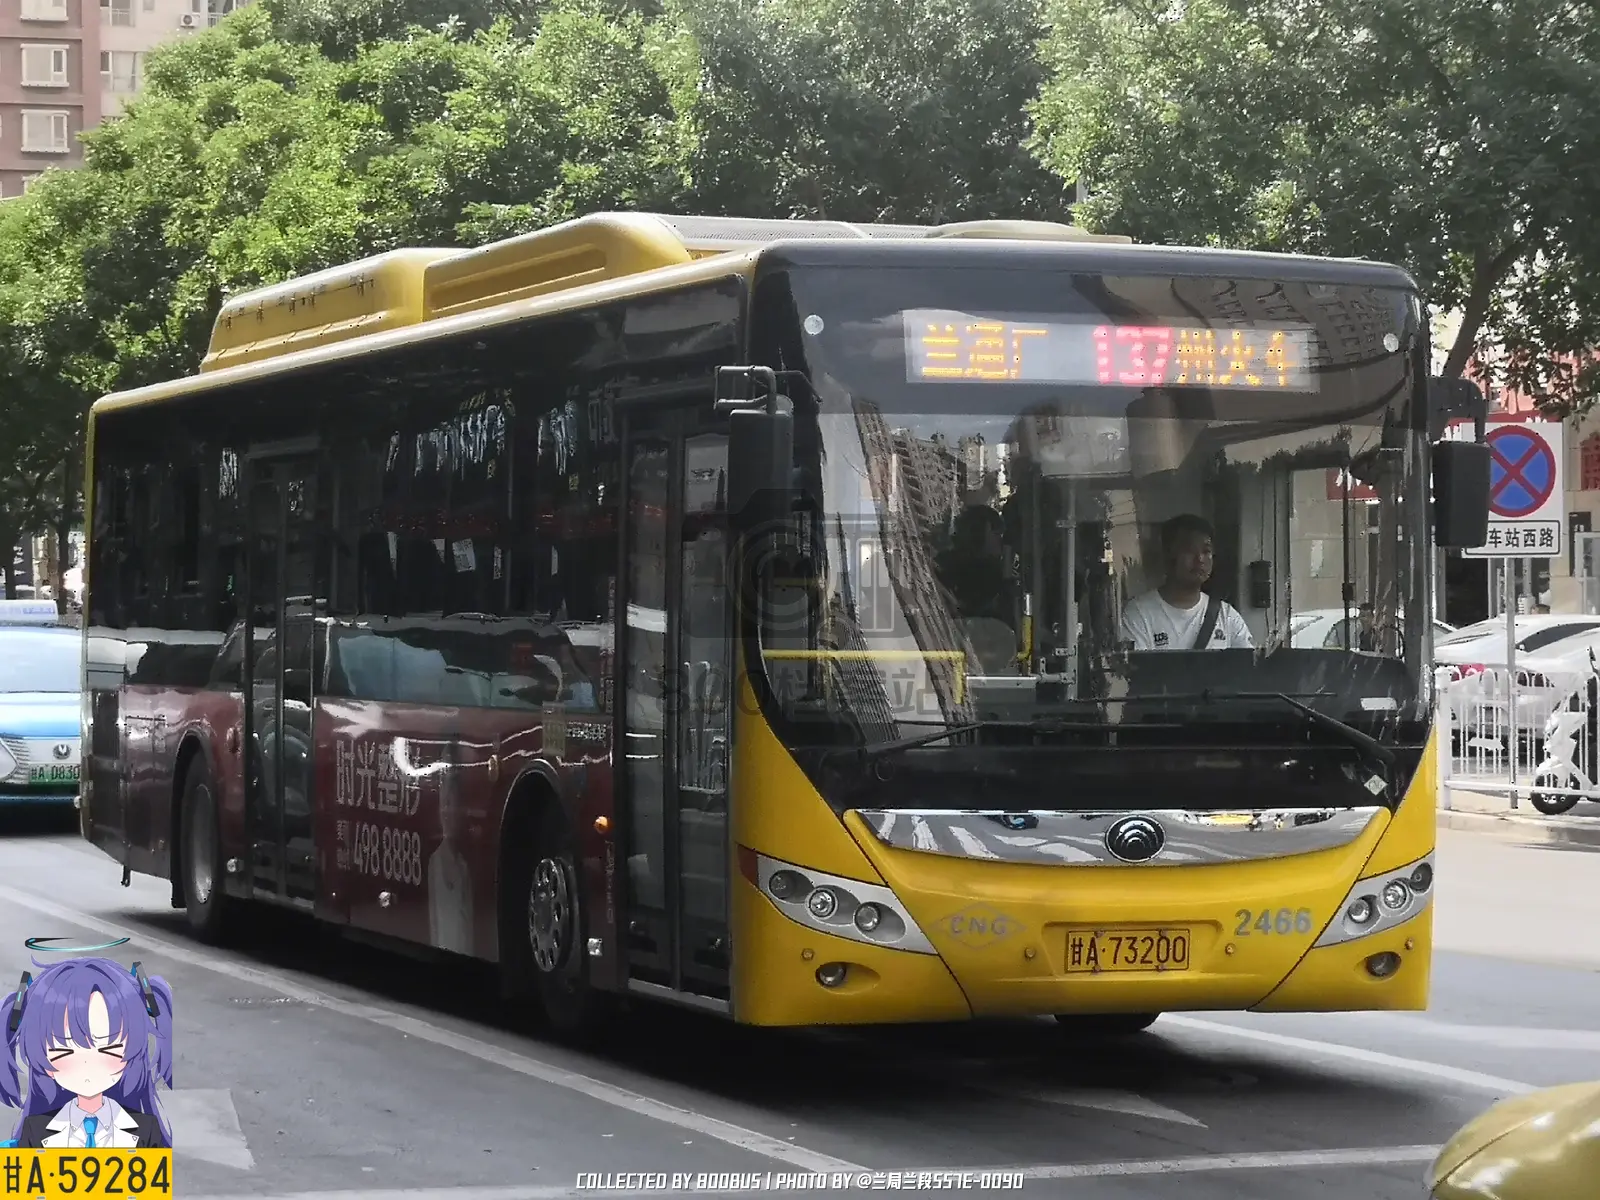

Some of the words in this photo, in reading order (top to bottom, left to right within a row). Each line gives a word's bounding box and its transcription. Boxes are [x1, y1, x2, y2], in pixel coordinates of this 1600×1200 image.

[1093, 324, 1173, 386] 137
[1487, 527, 1554, 548] 车站西路
[948, 915, 1007, 937] CNG
[1234, 908, 1311, 937] 2466
